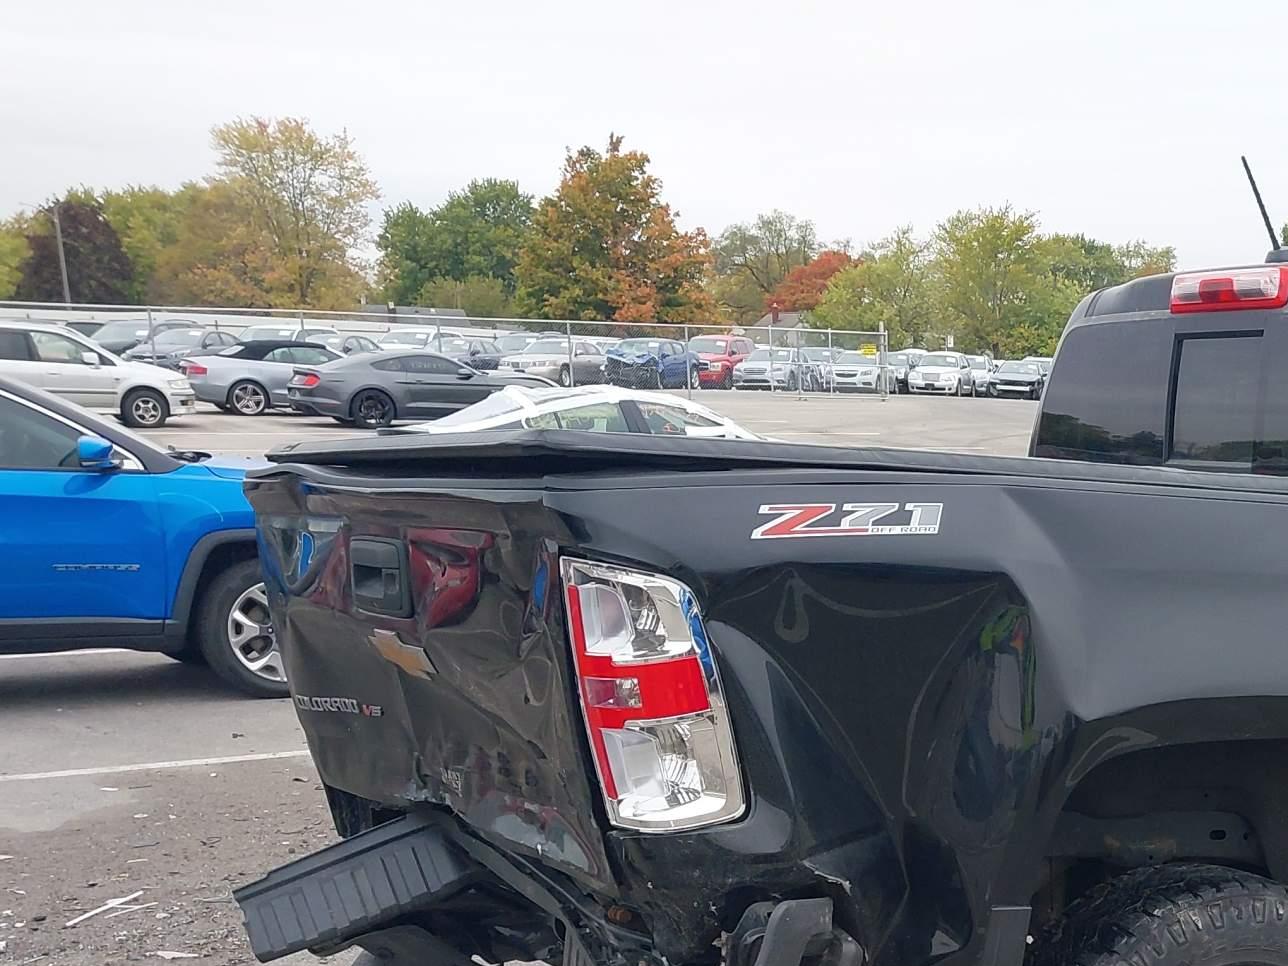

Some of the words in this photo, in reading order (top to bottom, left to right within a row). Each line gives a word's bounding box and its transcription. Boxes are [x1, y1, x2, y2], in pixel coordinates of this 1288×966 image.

[751, 502, 944, 539] Z71
[871, 526, 896, 534] OFF
[900, 526, 937, 534] ROAD
